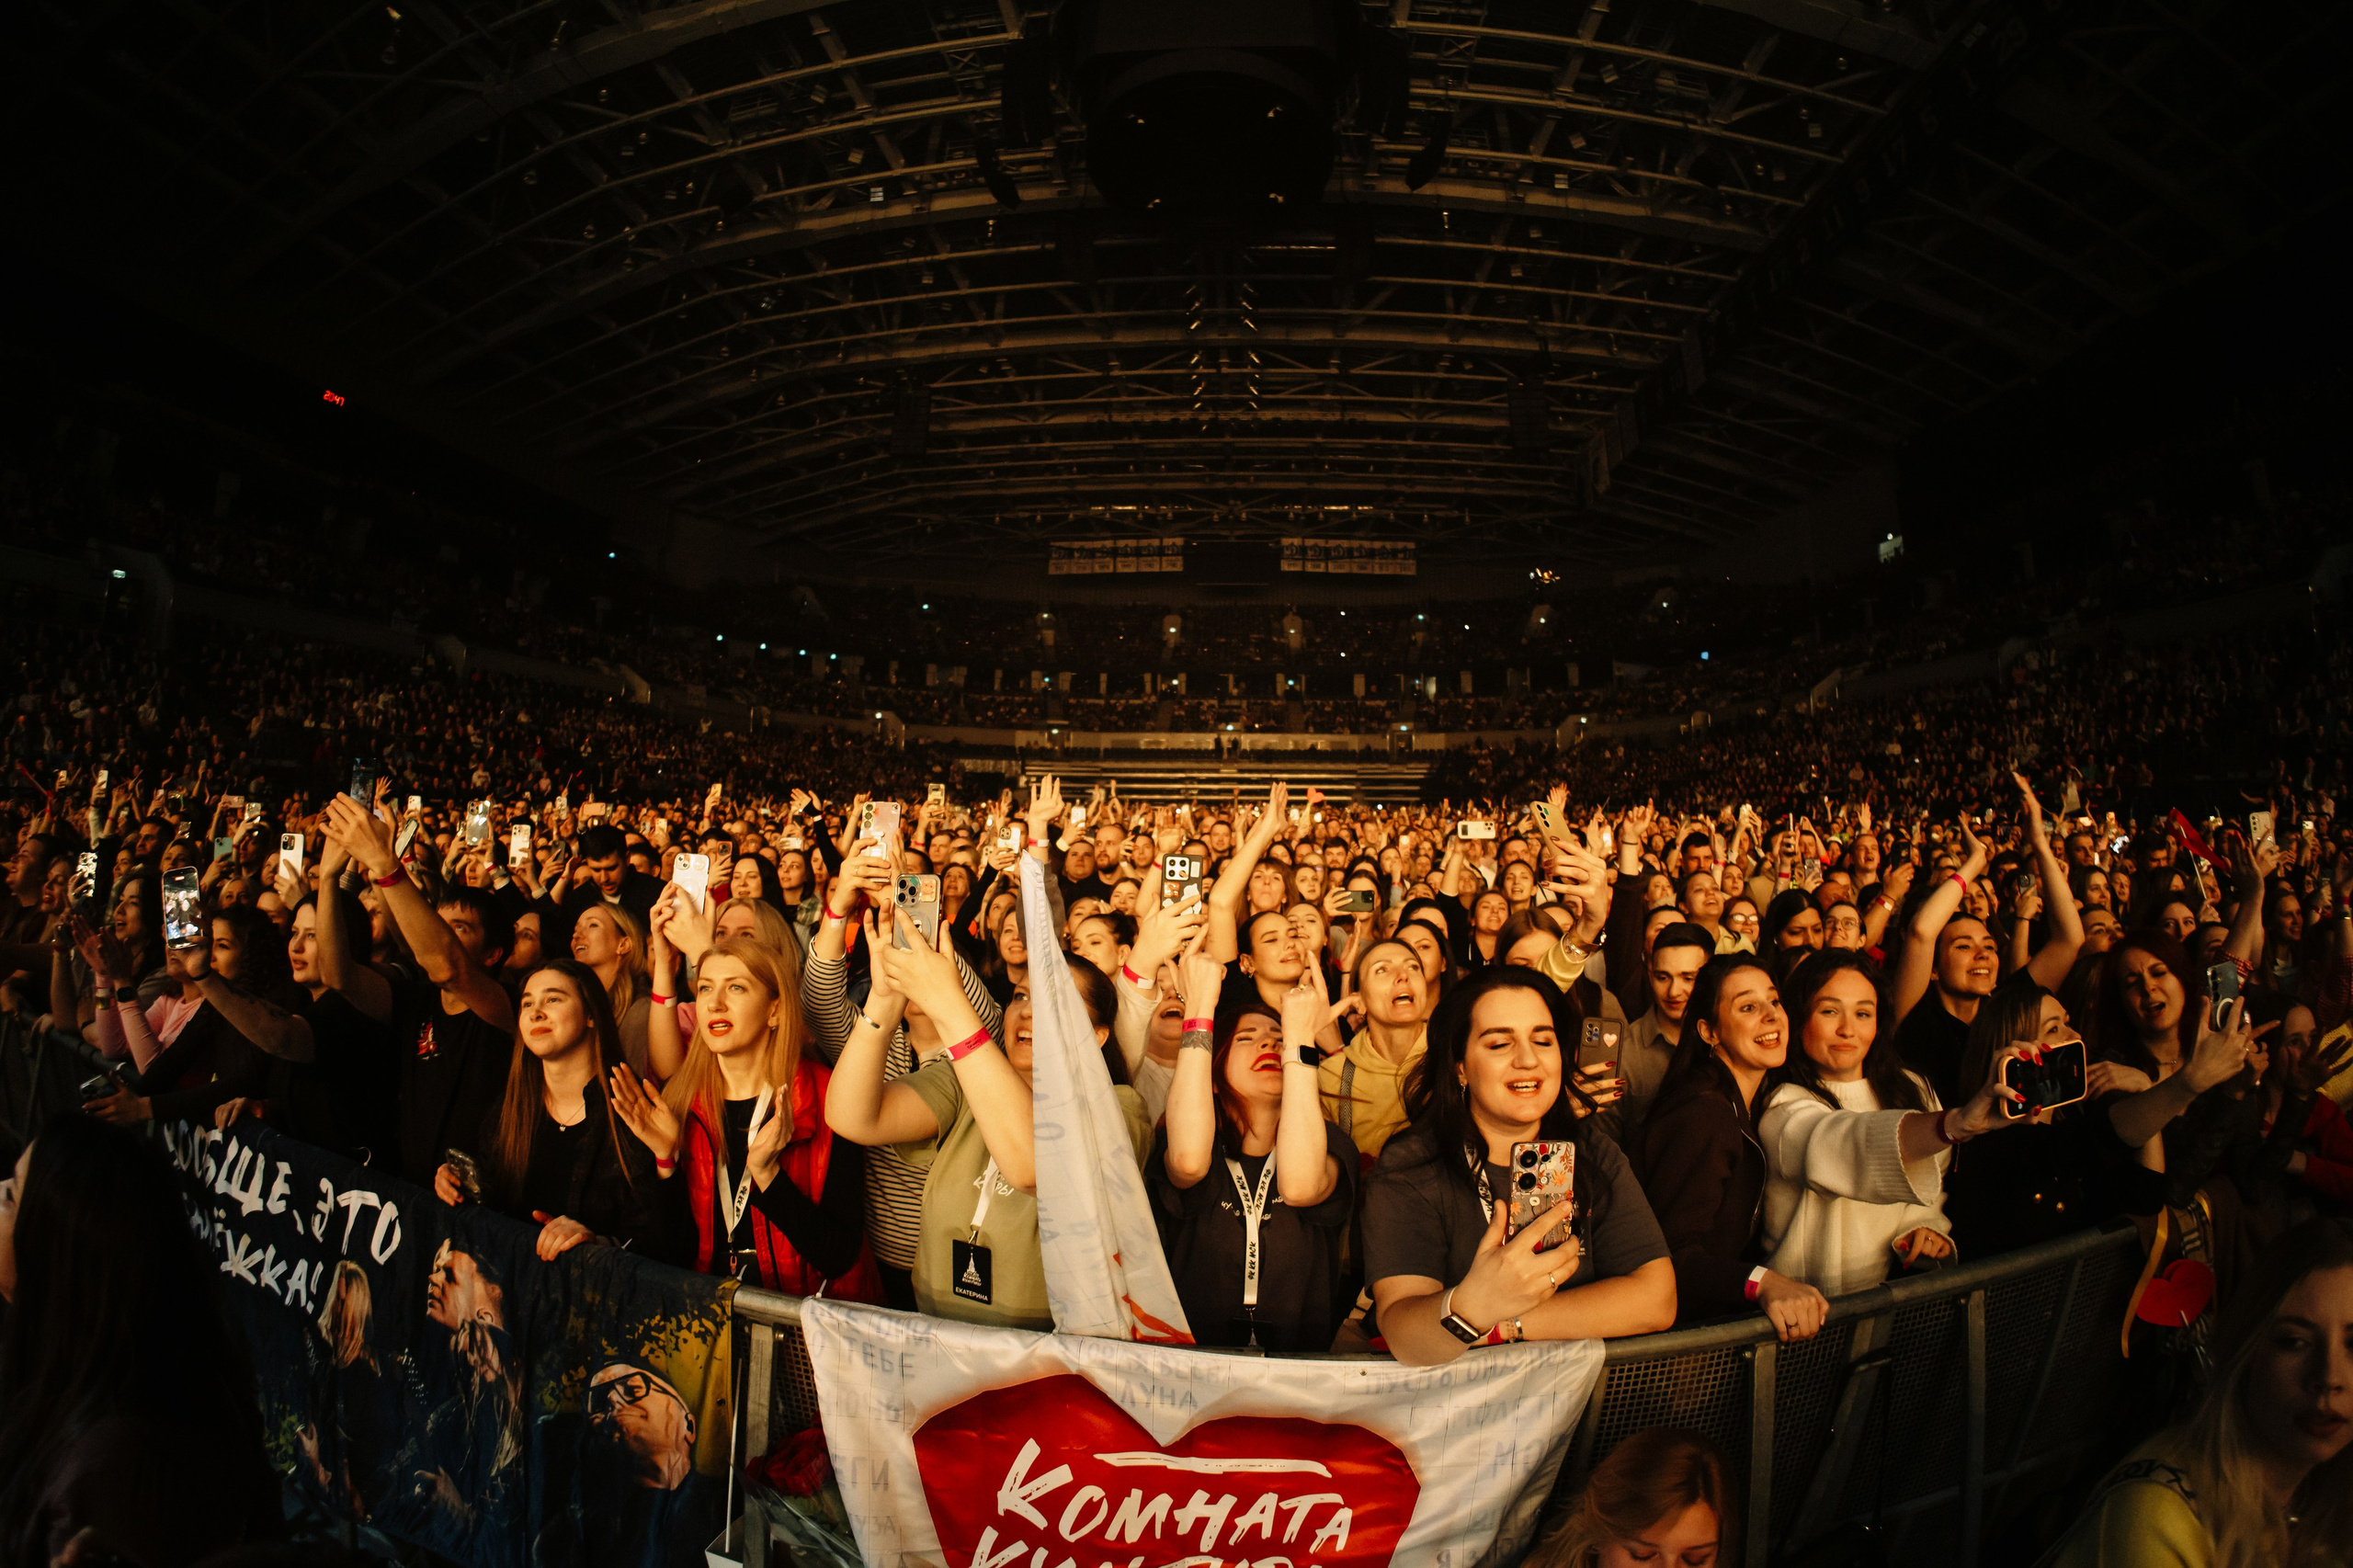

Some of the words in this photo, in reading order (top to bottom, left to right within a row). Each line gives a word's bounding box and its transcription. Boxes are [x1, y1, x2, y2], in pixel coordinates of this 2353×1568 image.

[311, 1177, 402, 1267] ЭТО
[955, 1287, 989, 1301] ЕКАТЕРИНА
[1120, 1380, 1199, 1409] ЛУНА
[997, 1437, 1353, 1554] КОМНАТА
